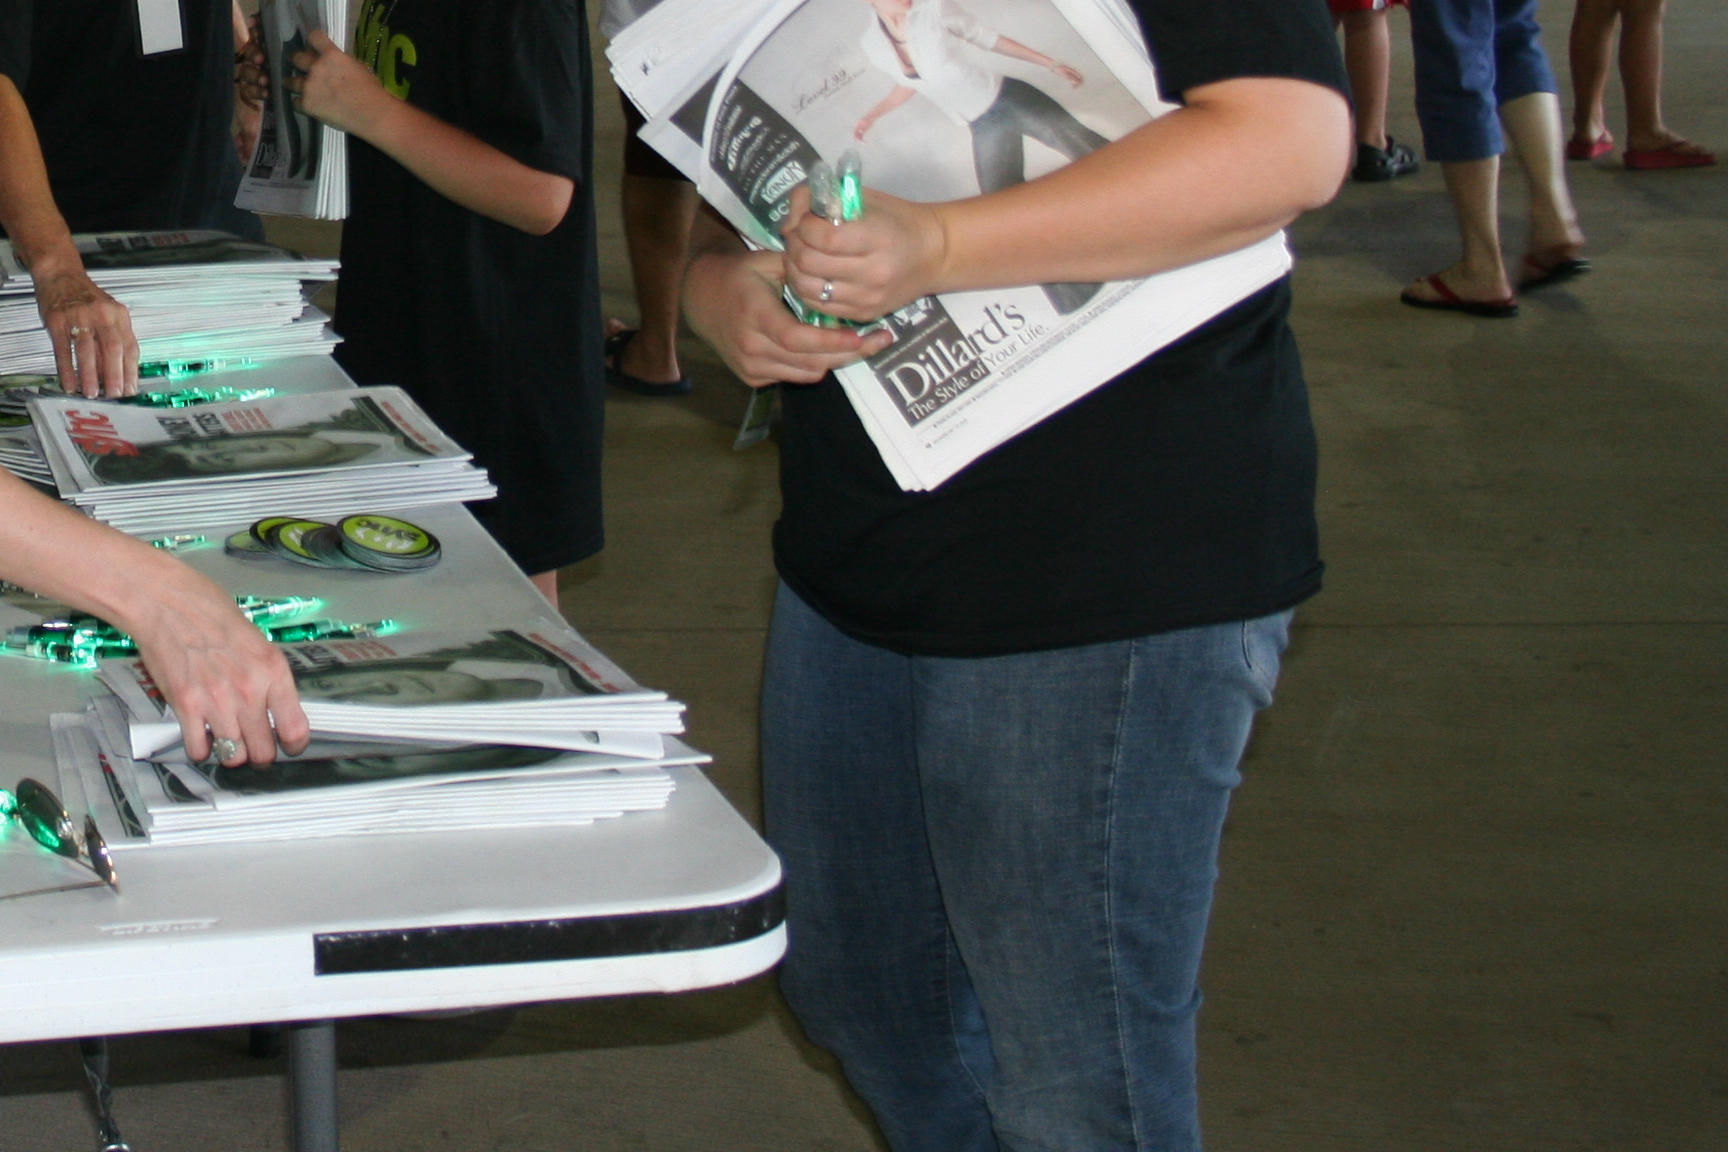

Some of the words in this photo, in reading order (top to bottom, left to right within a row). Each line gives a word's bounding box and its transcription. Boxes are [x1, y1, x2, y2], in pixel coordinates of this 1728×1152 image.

[885, 303, 1026, 408] Dillard's
[907, 398, 937, 420] The
[934, 374, 970, 404] Style
[970, 360, 987, 380] of
[984, 343, 1018, 370] Your
[1017, 322, 1050, 346] Life.
